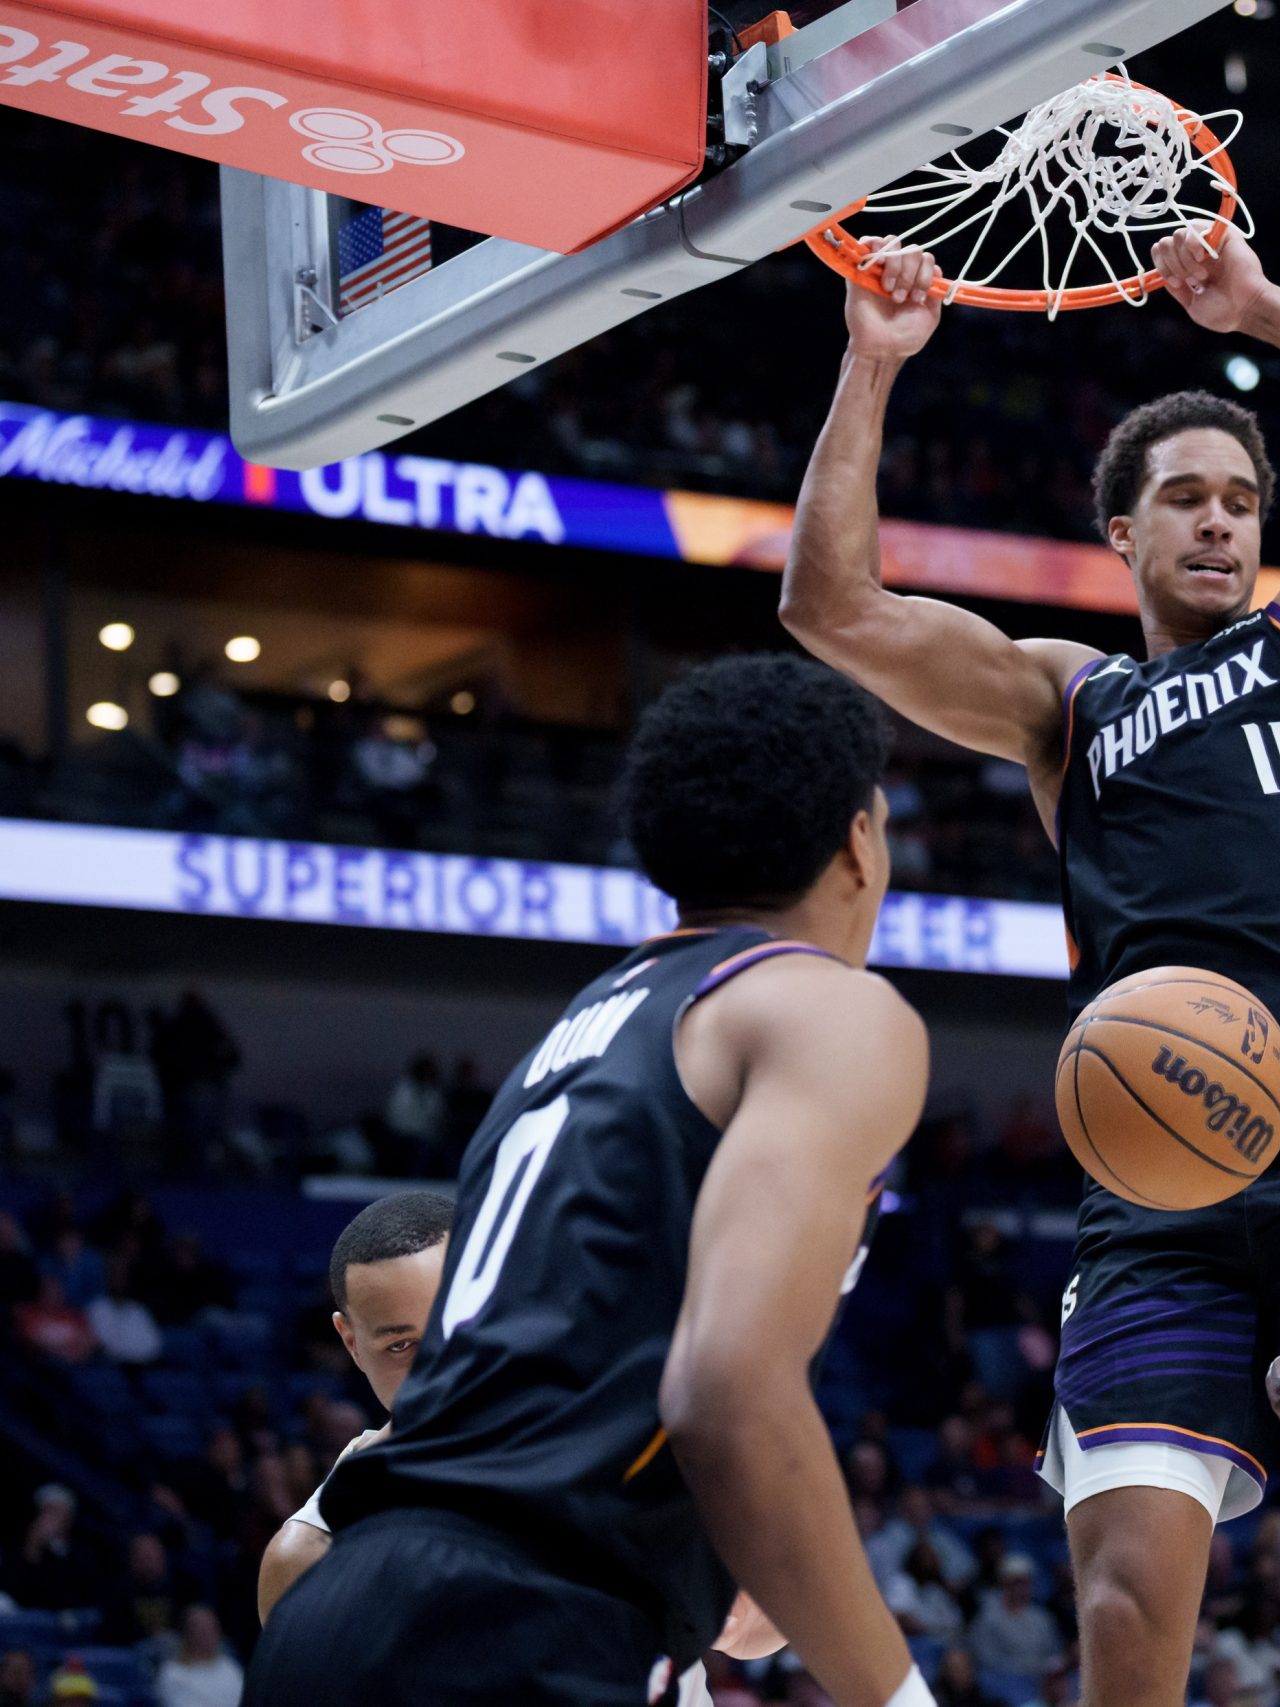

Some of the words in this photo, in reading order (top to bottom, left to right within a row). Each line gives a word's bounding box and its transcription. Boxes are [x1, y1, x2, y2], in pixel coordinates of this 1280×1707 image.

[299, 451, 567, 545] ULTRA
[1086, 636, 1280, 802] PHOENIX
[176, 832, 557, 938] SUPERIOR
[877, 890, 998, 974] EER
[1151, 1043, 1274, 1165] Wilson
[442, 1093, 570, 1341] 0
